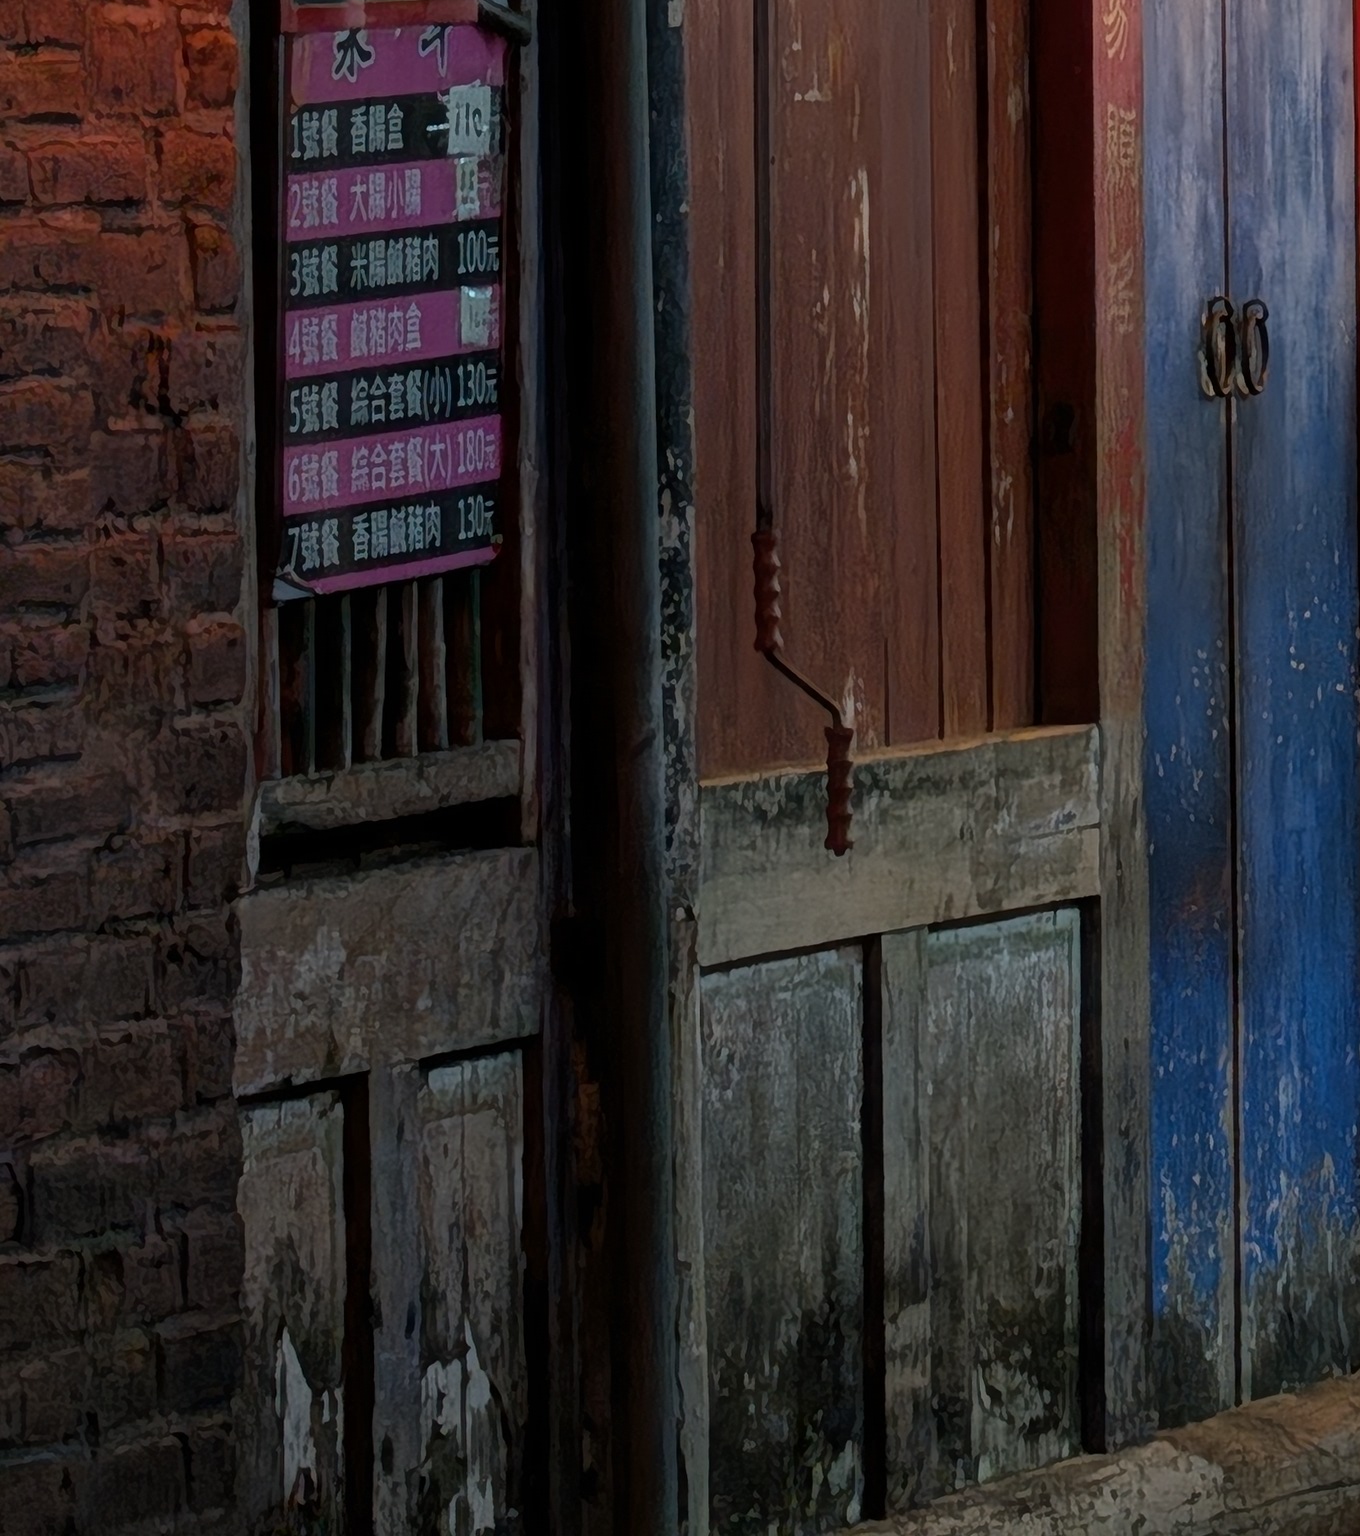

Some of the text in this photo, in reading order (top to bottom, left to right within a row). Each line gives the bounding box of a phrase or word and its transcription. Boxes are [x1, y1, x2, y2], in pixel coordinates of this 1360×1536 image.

[457, 229, 500, 276] 100元
[457, 362, 499, 408] 130元
[457, 493, 494, 541] 130元
